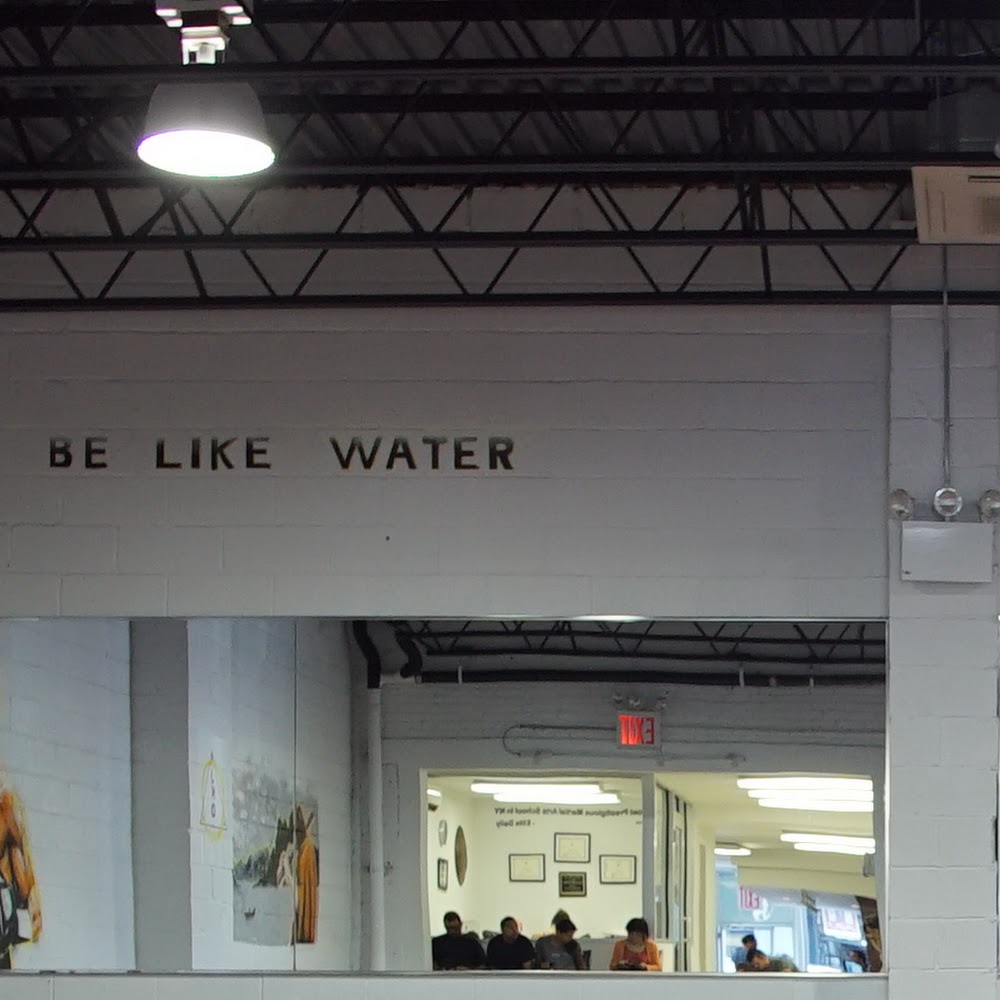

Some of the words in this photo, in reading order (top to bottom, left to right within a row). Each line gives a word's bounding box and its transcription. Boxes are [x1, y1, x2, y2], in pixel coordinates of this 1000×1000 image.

[50, 436, 108, 469] BE
[155, 436, 271, 470] LIKE
[329, 436, 515, 470] WATER
